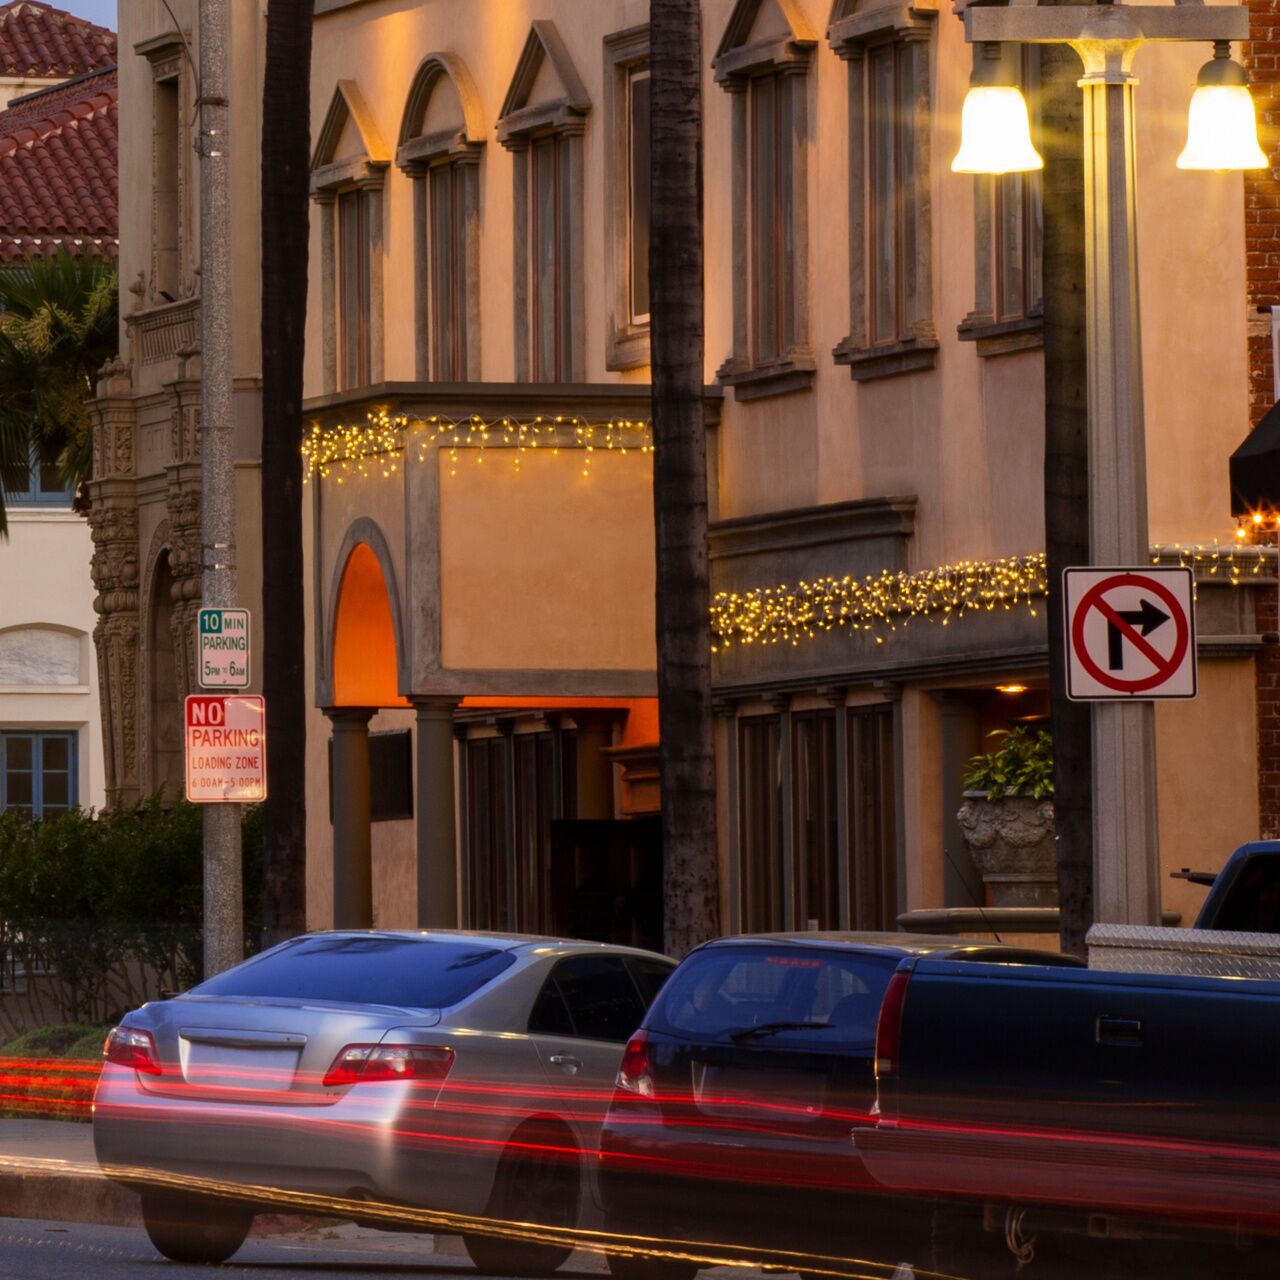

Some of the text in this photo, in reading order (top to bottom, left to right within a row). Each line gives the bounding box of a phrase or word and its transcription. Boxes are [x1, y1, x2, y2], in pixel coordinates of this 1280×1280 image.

[203, 613, 244, 630] 10 MIN
[203, 636, 246, 651] PARKING
[192, 702, 222, 725] NO
[192, 729, 259, 747] PARKING
[192, 756, 259, 769] LOADING ZONE
